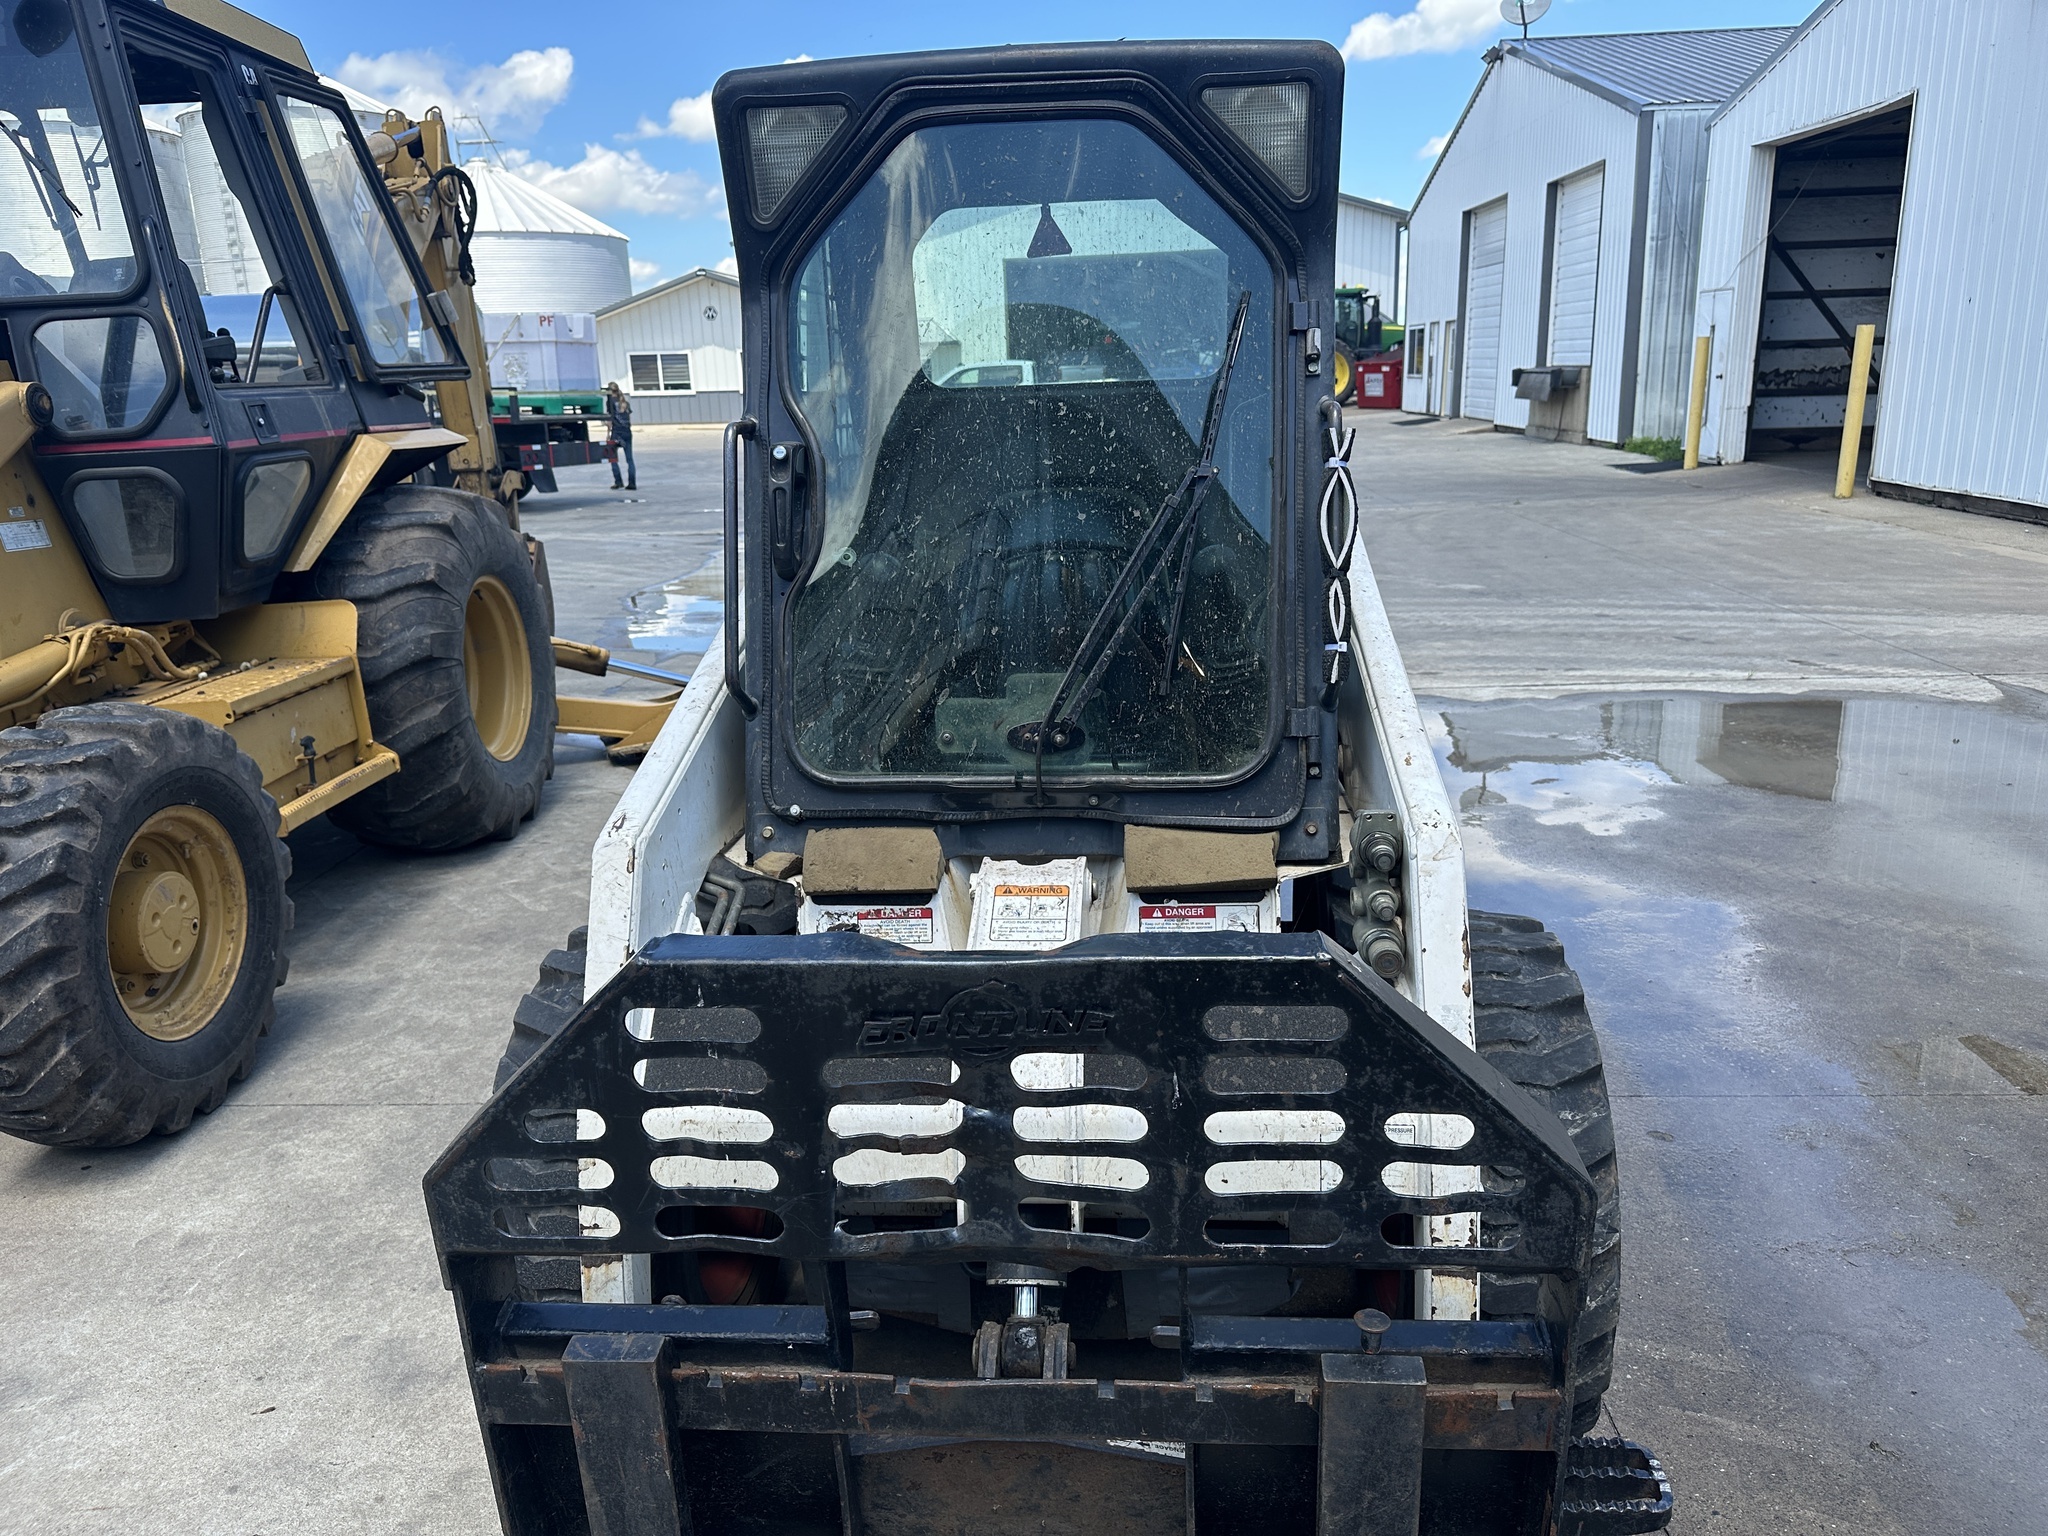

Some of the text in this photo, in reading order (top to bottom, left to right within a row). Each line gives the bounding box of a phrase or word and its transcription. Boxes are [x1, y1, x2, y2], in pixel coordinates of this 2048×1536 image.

[240, 64, 260, 86] CA
[539, 315, 555, 327] PF
[1165, 908, 1205, 916] DANGER
